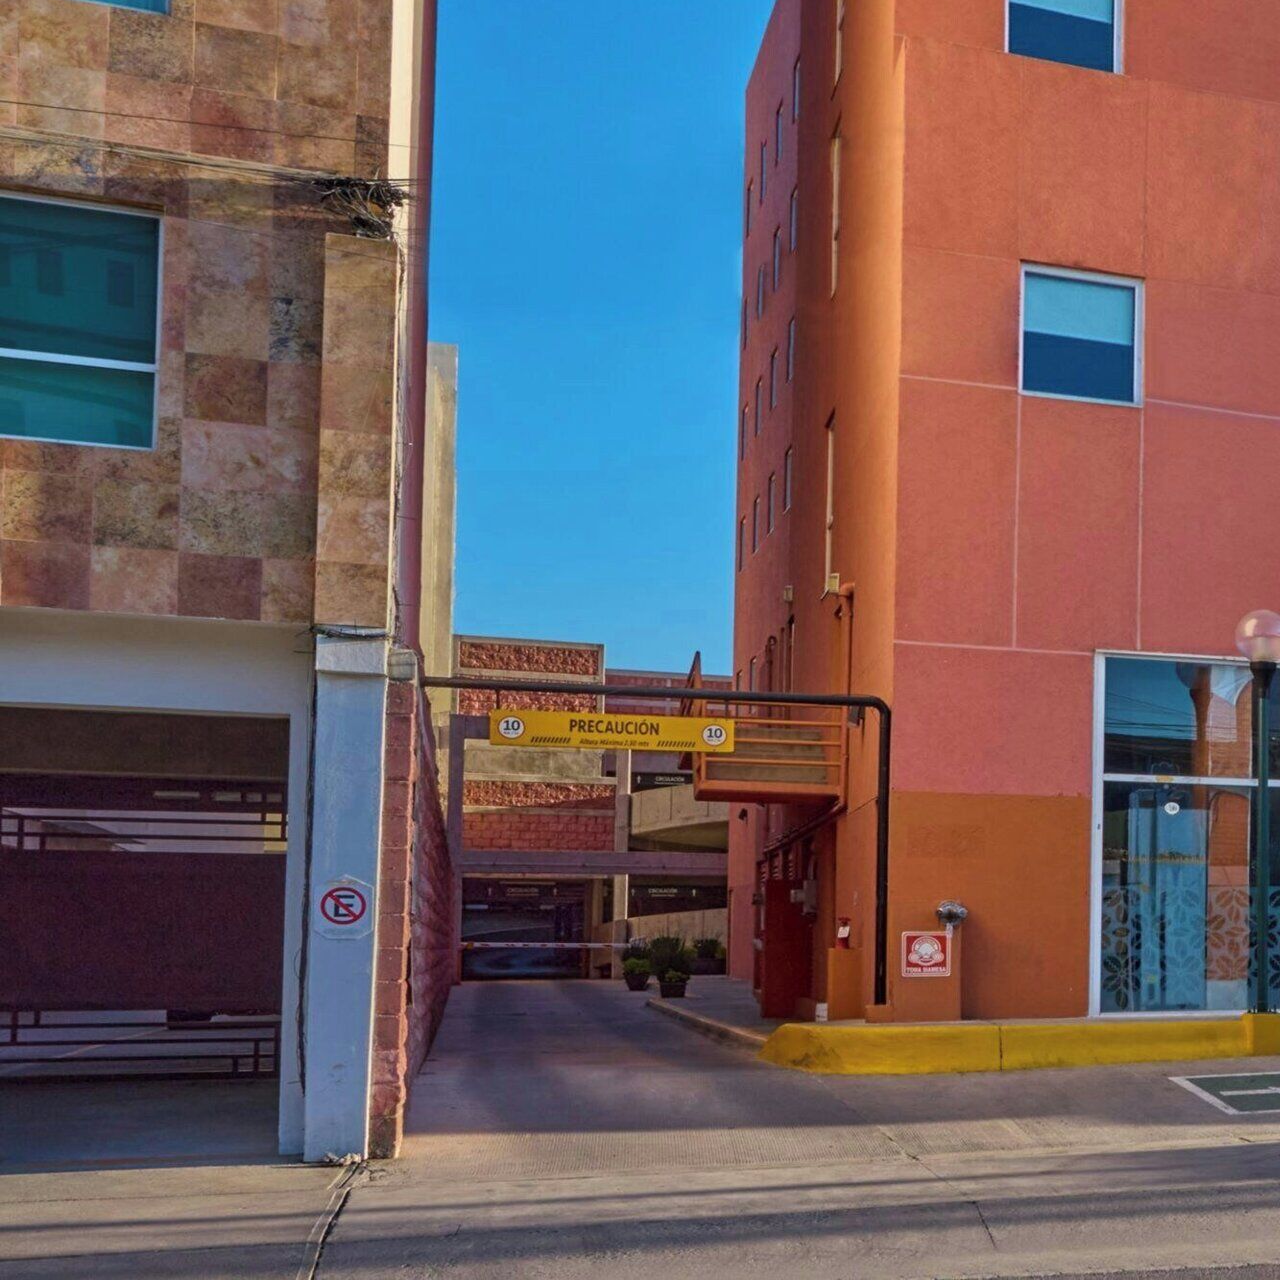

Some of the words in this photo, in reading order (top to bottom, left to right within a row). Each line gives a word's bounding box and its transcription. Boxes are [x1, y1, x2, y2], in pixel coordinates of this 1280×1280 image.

[502, 719, 521, 731] 10
[569, 718, 660, 736] PRECAUCIÓN
[706, 727, 723, 739] 10
[334, 894, 355, 918] E
